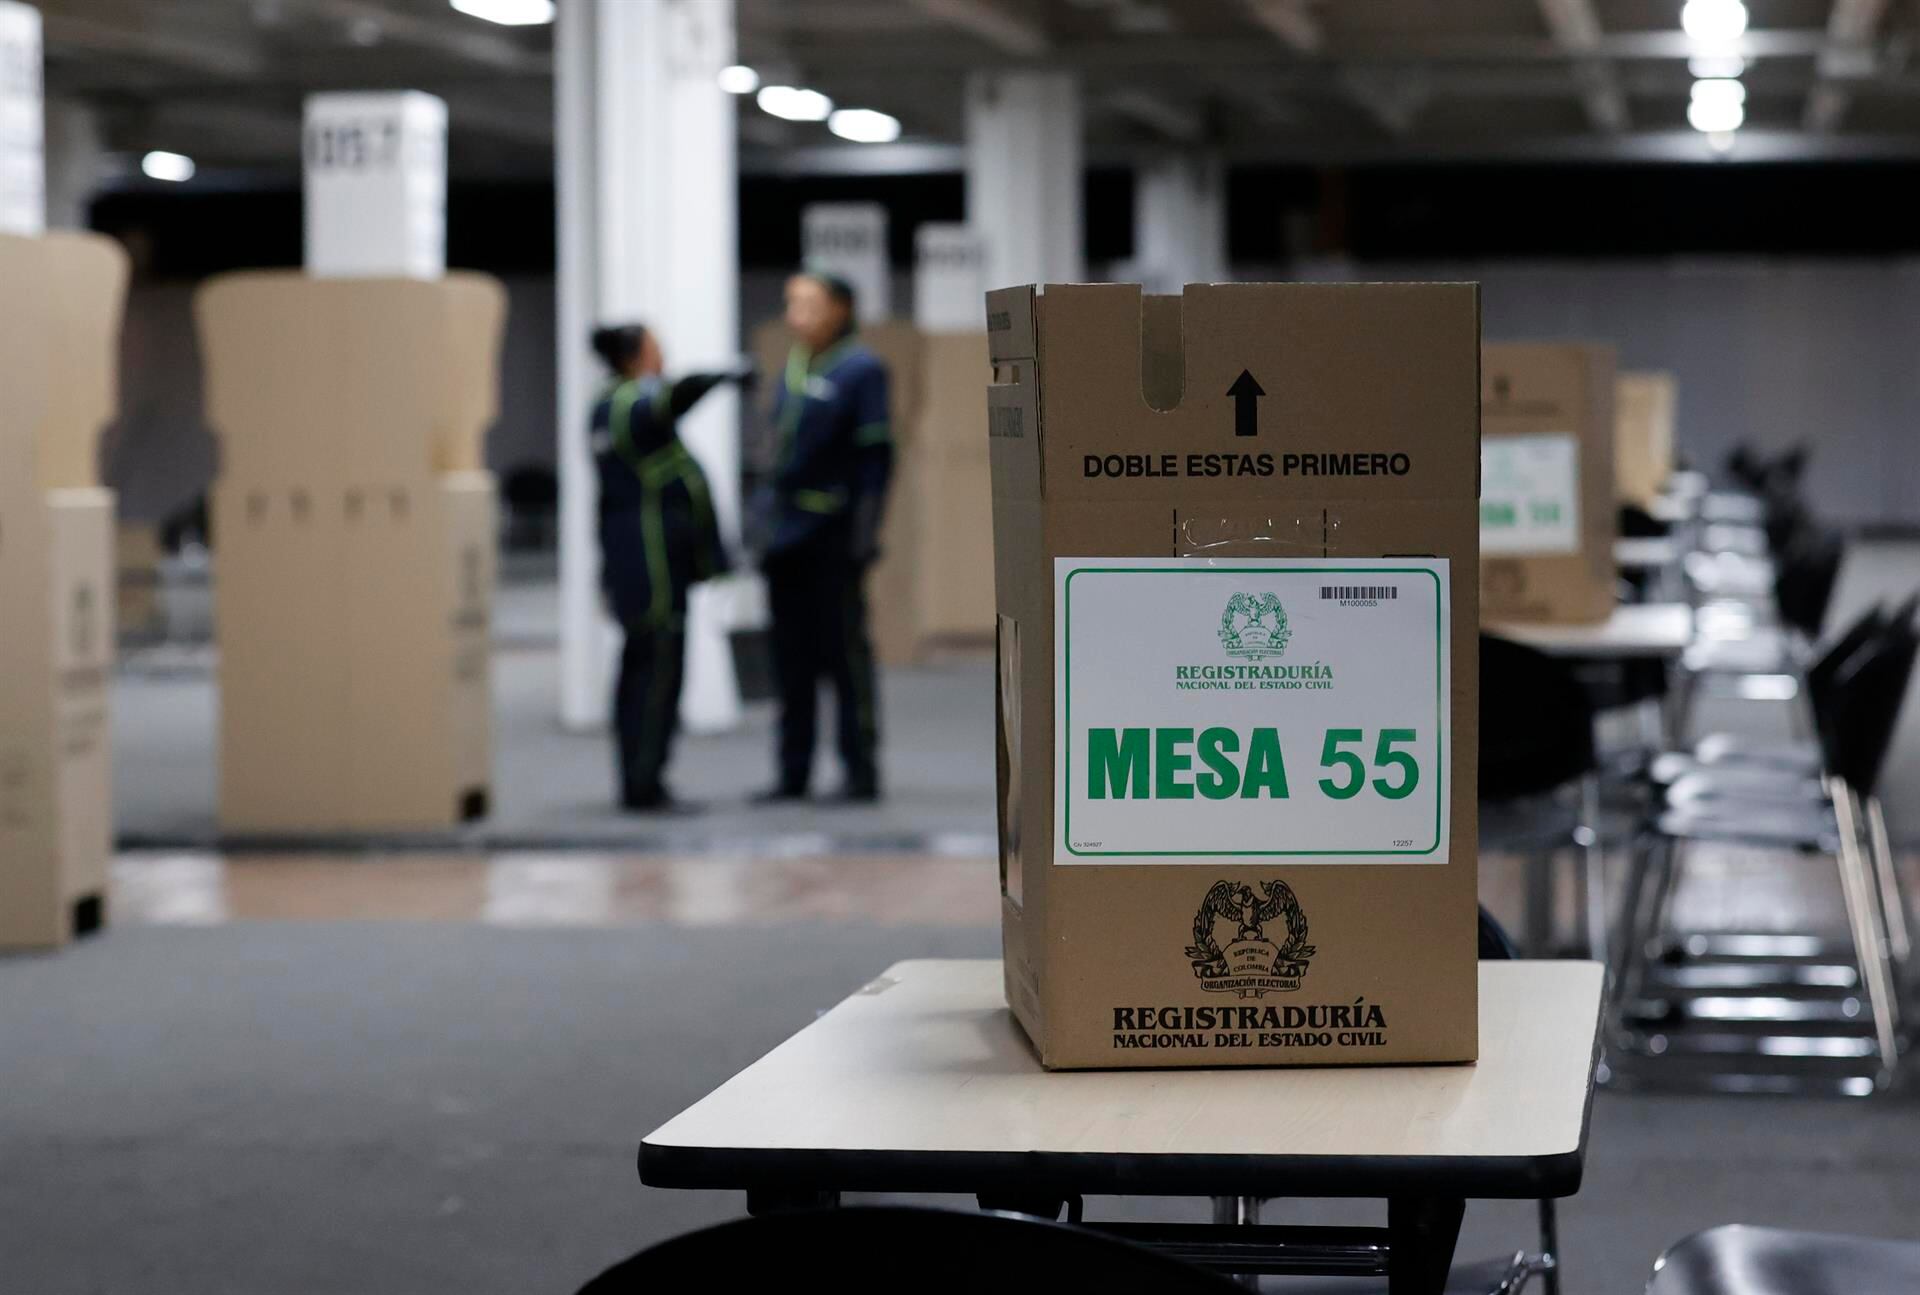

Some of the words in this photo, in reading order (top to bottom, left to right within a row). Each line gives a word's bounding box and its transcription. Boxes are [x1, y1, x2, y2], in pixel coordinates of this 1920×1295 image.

[1083, 454, 1178, 478] DOBLE
[1186, 454, 1275, 477] ESTAS
[1282, 453, 1411, 476] PRIMERO
[1176, 661, 1333, 679] REGISTRADURÍA
[1176, 681, 1231, 690] NACIONAL
[1234, 681, 1257, 689] DEL
[1260, 681, 1302, 689] ESTADO
[1305, 681, 1334, 689] CIVIL
[1088, 727, 1289, 800] MESA
[1318, 728, 1420, 800] 55
[1203, 977, 1257, 988] ORGANIZACIÓN
[1258, 979, 1298, 988] ELECTORAL
[1113, 997, 1387, 1030] REGISTRADURÍA
[1113, 1034, 1209, 1048] NACIONAL
[1214, 1034, 1253, 1047] DEL
[1258, 1033, 1333, 1047] ESTADO
[1337, 1032, 1387, 1046] CIVIL
